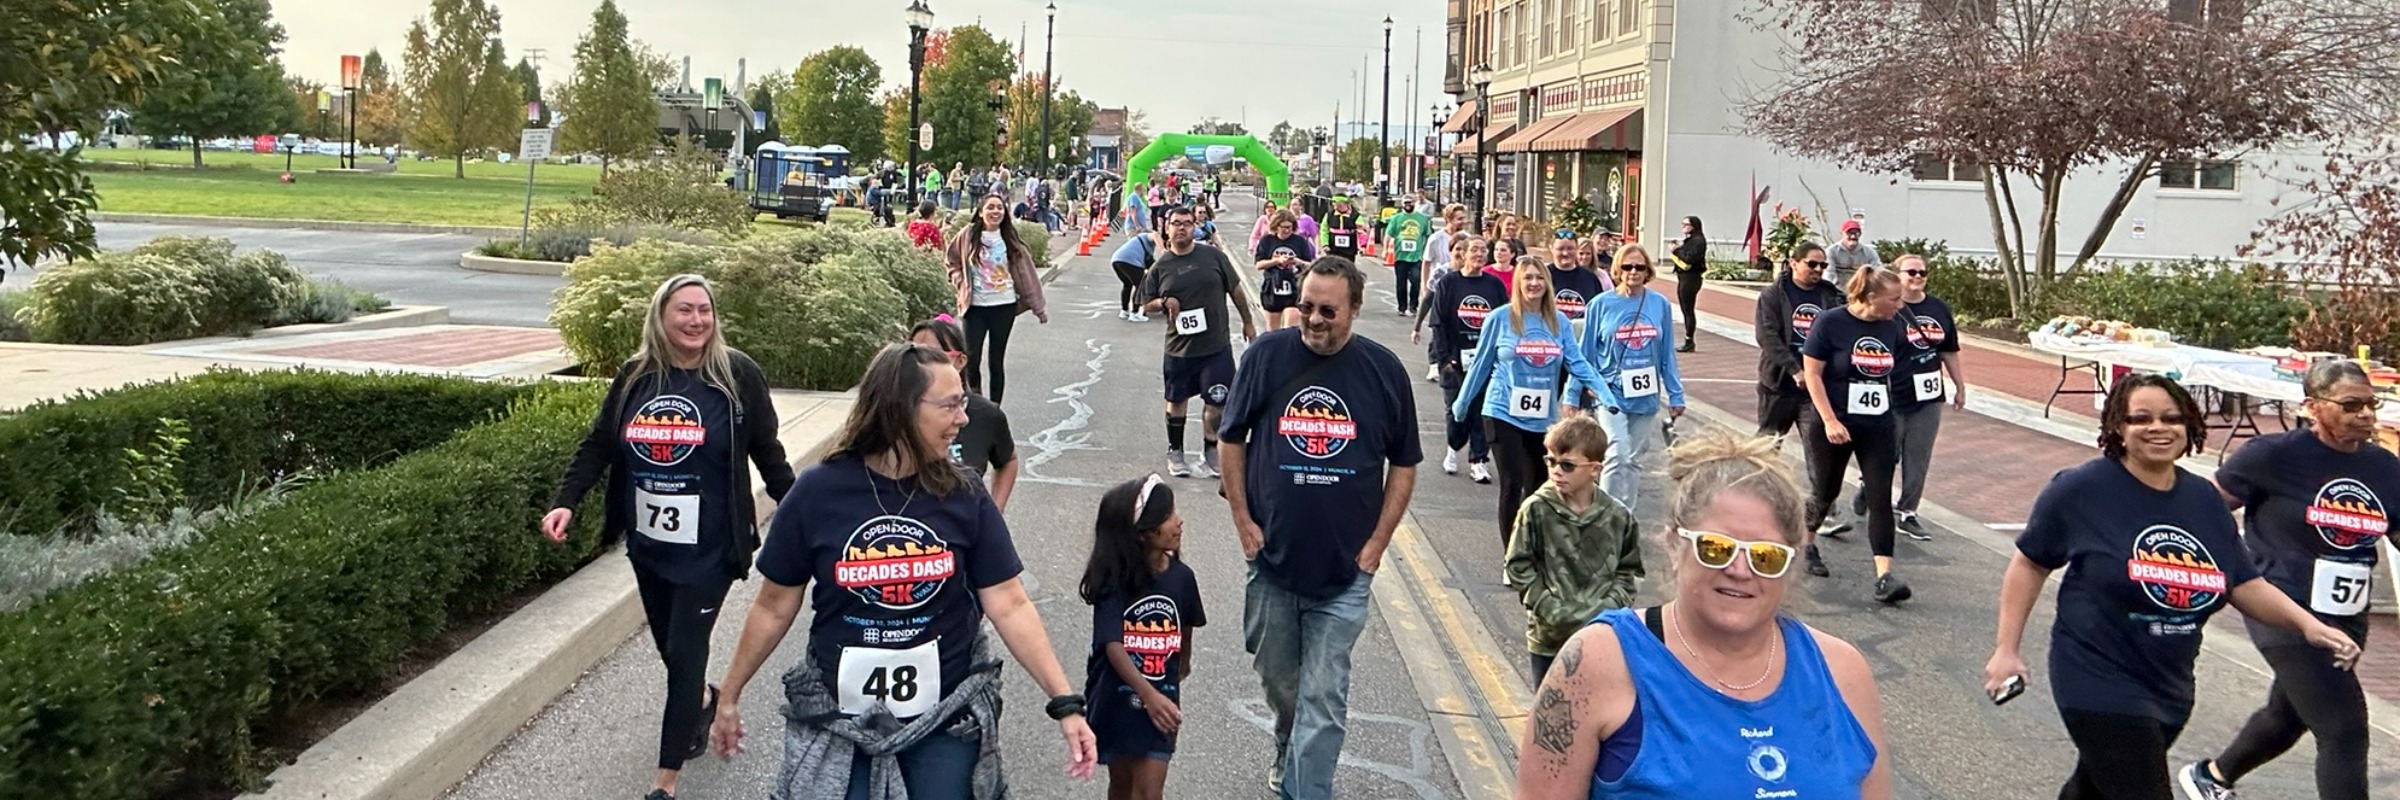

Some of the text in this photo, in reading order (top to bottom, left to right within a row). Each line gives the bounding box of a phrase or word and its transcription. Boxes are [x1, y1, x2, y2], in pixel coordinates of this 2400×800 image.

[1181, 315, 1199, 329] 85
[1631, 373, 1651, 391] 63
[1923, 377, 1939, 393] 93
[649, 399, 692, 413] OPEN DOOR
[1520, 394, 1542, 411] 64
[1858, 391, 1881, 408] 46
[626, 425, 704, 442] DECADES DASH
[1281, 420, 1355, 436] DECADES DASH
[651, 445, 673, 461] 5K
[1306, 438, 1329, 454] 5K
[646, 503, 680, 532] 73
[2309, 510, 2387, 532] DECADES DAS
[863, 523, 924, 540] OPEN DOOR
[2145, 532, 2198, 550] OPEN DOOR
[838, 556, 955, 583] DECADES DASH
[2132, 563, 2226, 589] DECADES DASH
[881, 584, 914, 604] 5K
[912, 581, 936, 599] WALK
[2166, 587, 2192, 607] 5K
[2331, 575, 2367, 604] 57
[1134, 601, 1175, 616] OPEN DOOR
[1124, 635, 1165, 650] ECADES
[1143, 655, 1166, 675] 5K
[862, 665, 918, 702] 48
